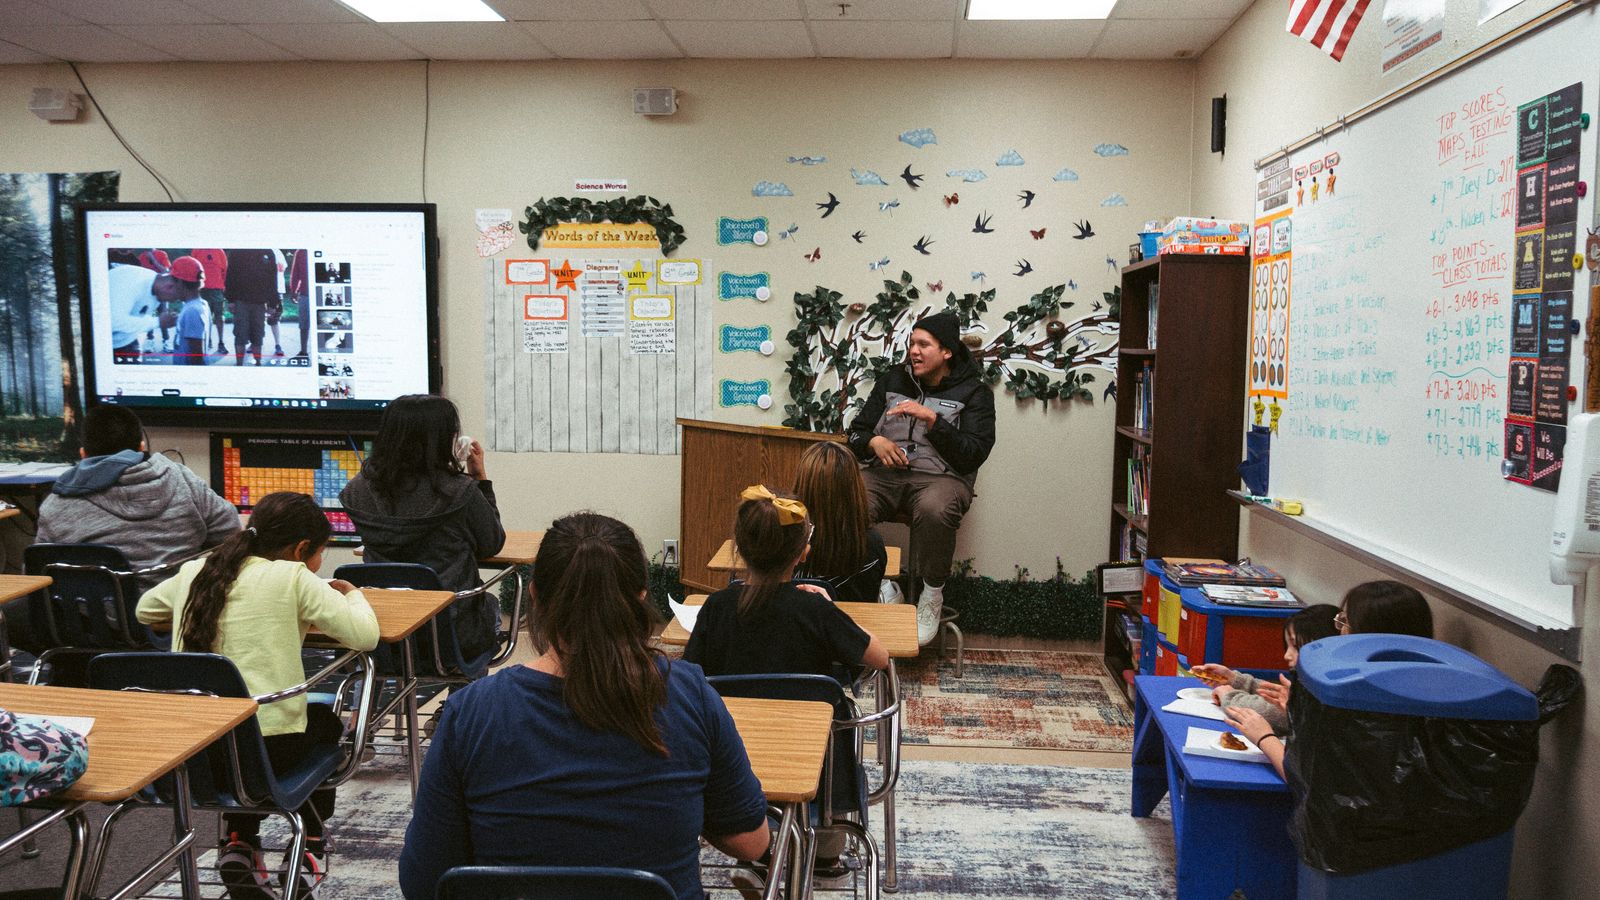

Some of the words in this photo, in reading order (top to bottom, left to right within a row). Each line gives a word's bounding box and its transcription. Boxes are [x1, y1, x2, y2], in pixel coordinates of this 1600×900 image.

[1436, 111, 1457, 134] TOP
[1462, 86, 1507, 121] SCORES
[1528, 108, 1539, 130] C
[1438, 132, 1466, 161] MAPS
[1526, 176, 1536, 198] H
[544, 231, 583, 241] Words
[586, 230, 600, 241] of
[602, 230, 620, 241] the
[623, 230, 657, 241] Week
[586, 264, 619, 272] Diagrams
[1432, 253, 1447, 270] TOP
[1442, 264, 1472, 285] CLASS
[1475, 252, 1507, 275] TOTALS
[554, 269, 575, 277] UNIT
[1482, 288, 1499, 310] pts
[1486, 311, 1505, 336] pts
[1519, 304, 1533, 325] M
[1485, 337, 1505, 361] pts
[1518, 365, 1528, 385] P
[1482, 379, 1497, 401] pts
[1486, 406, 1502, 430] pts
[1515, 433, 1525, 453] S
[1540, 430, 1551, 443] We
[1486, 435, 1501, 462] pts
[1545, 448, 1555, 461] Be
